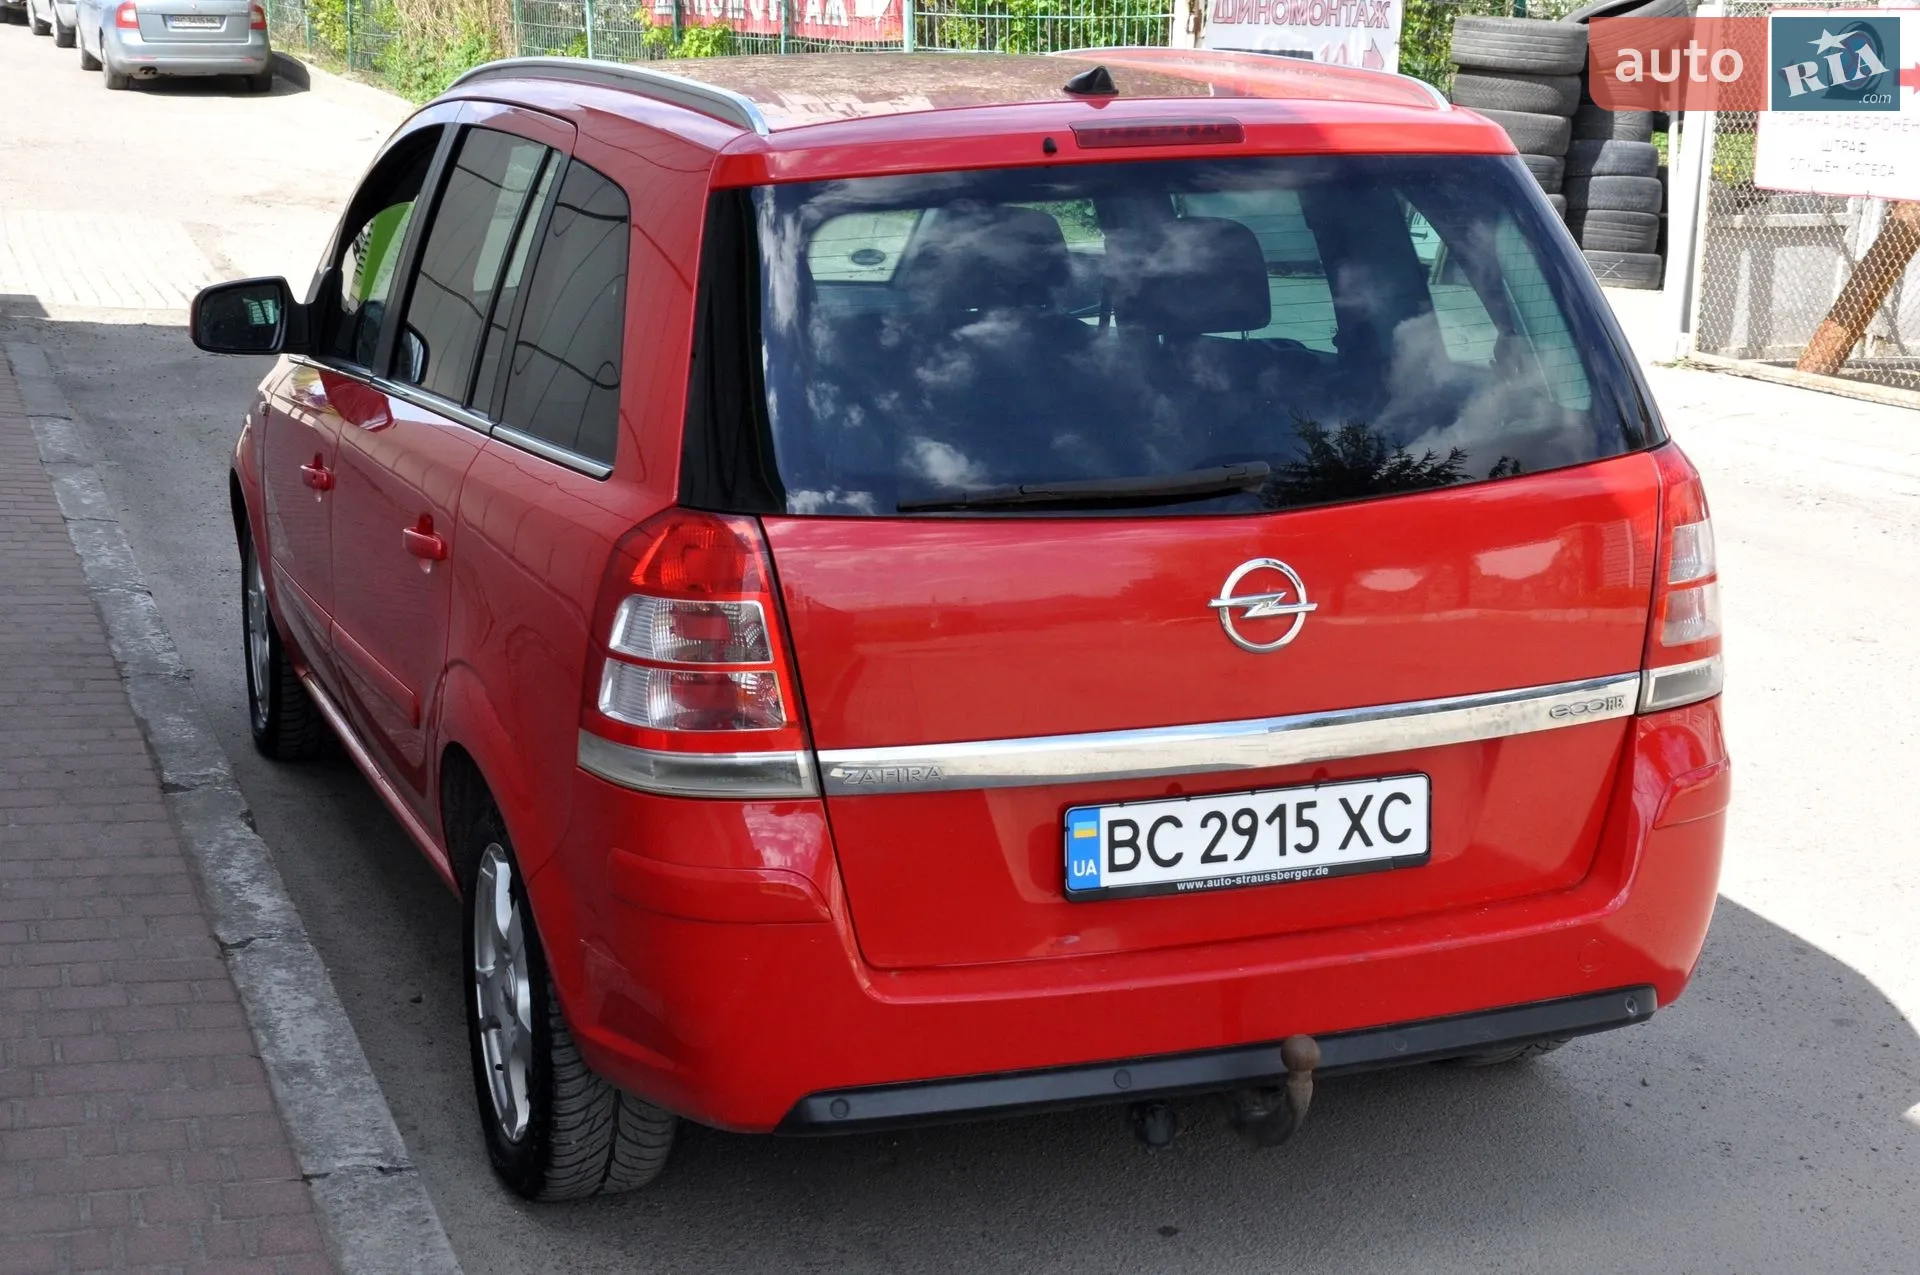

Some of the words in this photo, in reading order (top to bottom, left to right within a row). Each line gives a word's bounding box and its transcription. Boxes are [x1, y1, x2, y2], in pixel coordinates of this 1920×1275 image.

[1212, 0, 1390, 29] ШИНОМОНТАЖ
[1820, 138, 1867, 154] ШТРАФ
[843, 766, 947, 785] ZAFIRA
[1106, 815, 1184, 873] BC
[1199, 800, 1321, 865] 2915
[1337, 791, 1412, 851] XC
[1073, 859, 1098, 877] UA
[1176, 865, 1329, 891] www.auto-straussberger.de
